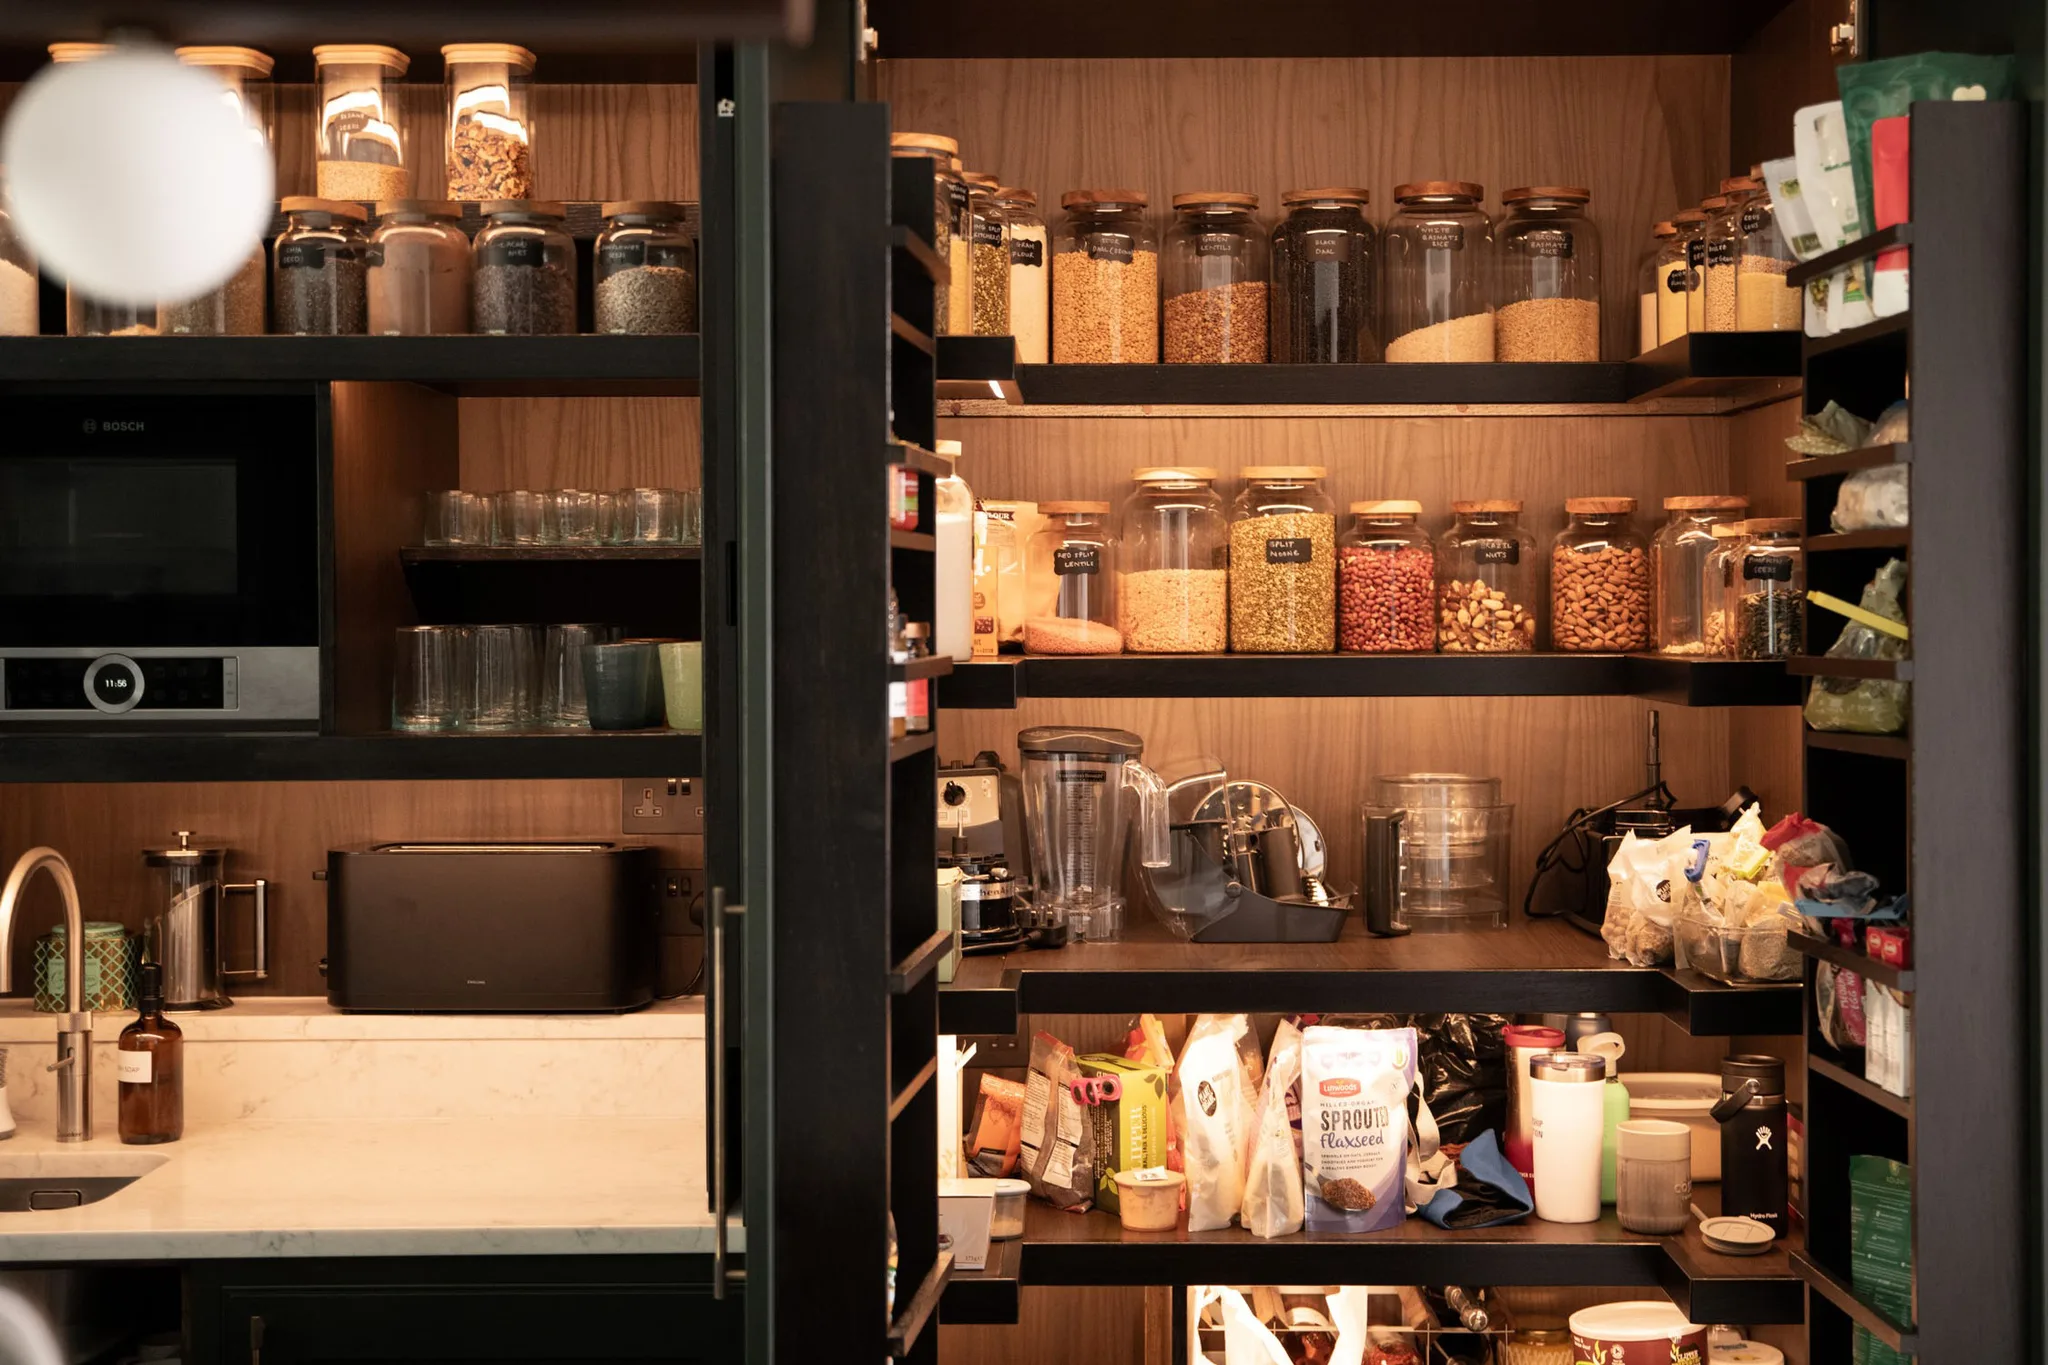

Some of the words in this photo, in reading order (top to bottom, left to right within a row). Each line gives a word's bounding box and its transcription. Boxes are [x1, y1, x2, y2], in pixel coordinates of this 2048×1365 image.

[103, 421, 145, 431] BOSCH
[1064, 560, 1094, 568] LENTILS
[105, 679, 127, 688] 11:56
[1321, 1106, 1389, 1131] SPROUTED
[1320, 1128, 1384, 1149] flaxseed
